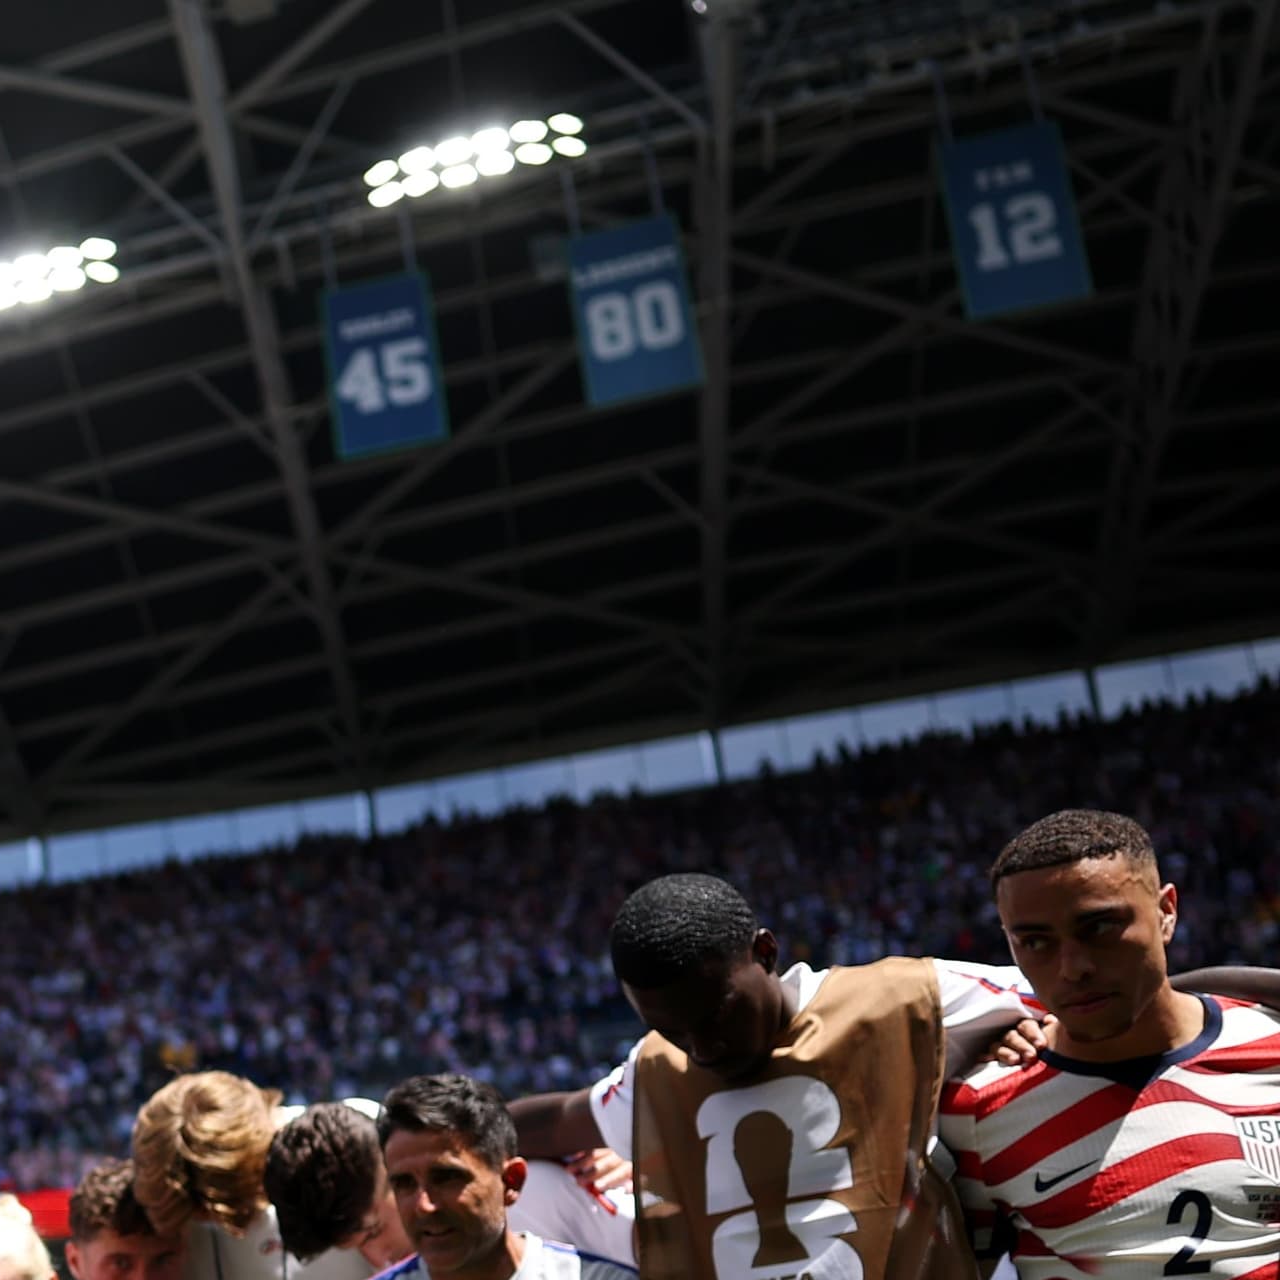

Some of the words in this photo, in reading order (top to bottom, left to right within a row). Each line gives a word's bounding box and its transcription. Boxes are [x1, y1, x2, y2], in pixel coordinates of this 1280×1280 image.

[969, 191, 1062, 272] 12
[586, 280, 684, 362] 80
[337, 337, 431, 414] 45
[1164, 1189, 1213, 1277] 2
